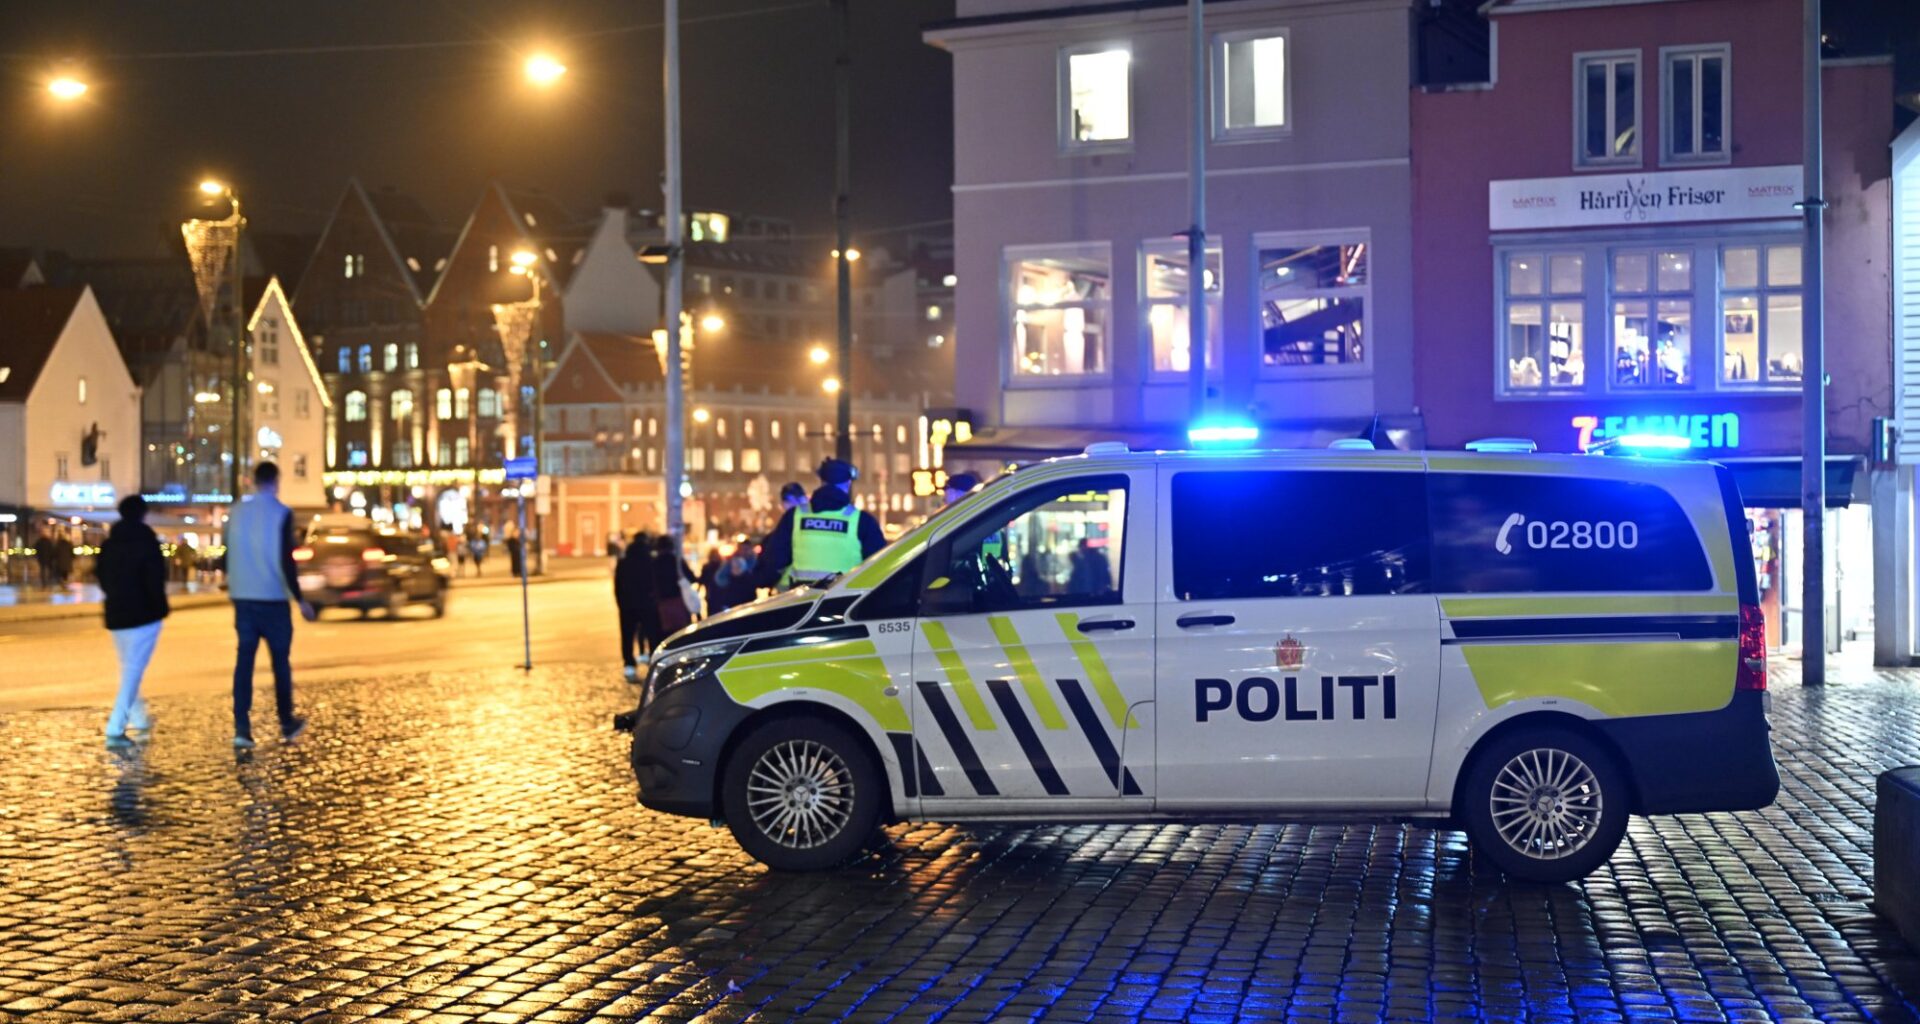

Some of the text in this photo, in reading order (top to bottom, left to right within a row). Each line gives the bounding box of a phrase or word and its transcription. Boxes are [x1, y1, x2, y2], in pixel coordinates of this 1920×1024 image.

[1668, 186, 1726, 207] Frisør
[805, 519, 844, 531] POLITI
[1527, 521, 1638, 549] 02800
[878, 621, 911, 634] 6535
[1195, 675, 1396, 723] POLITI
